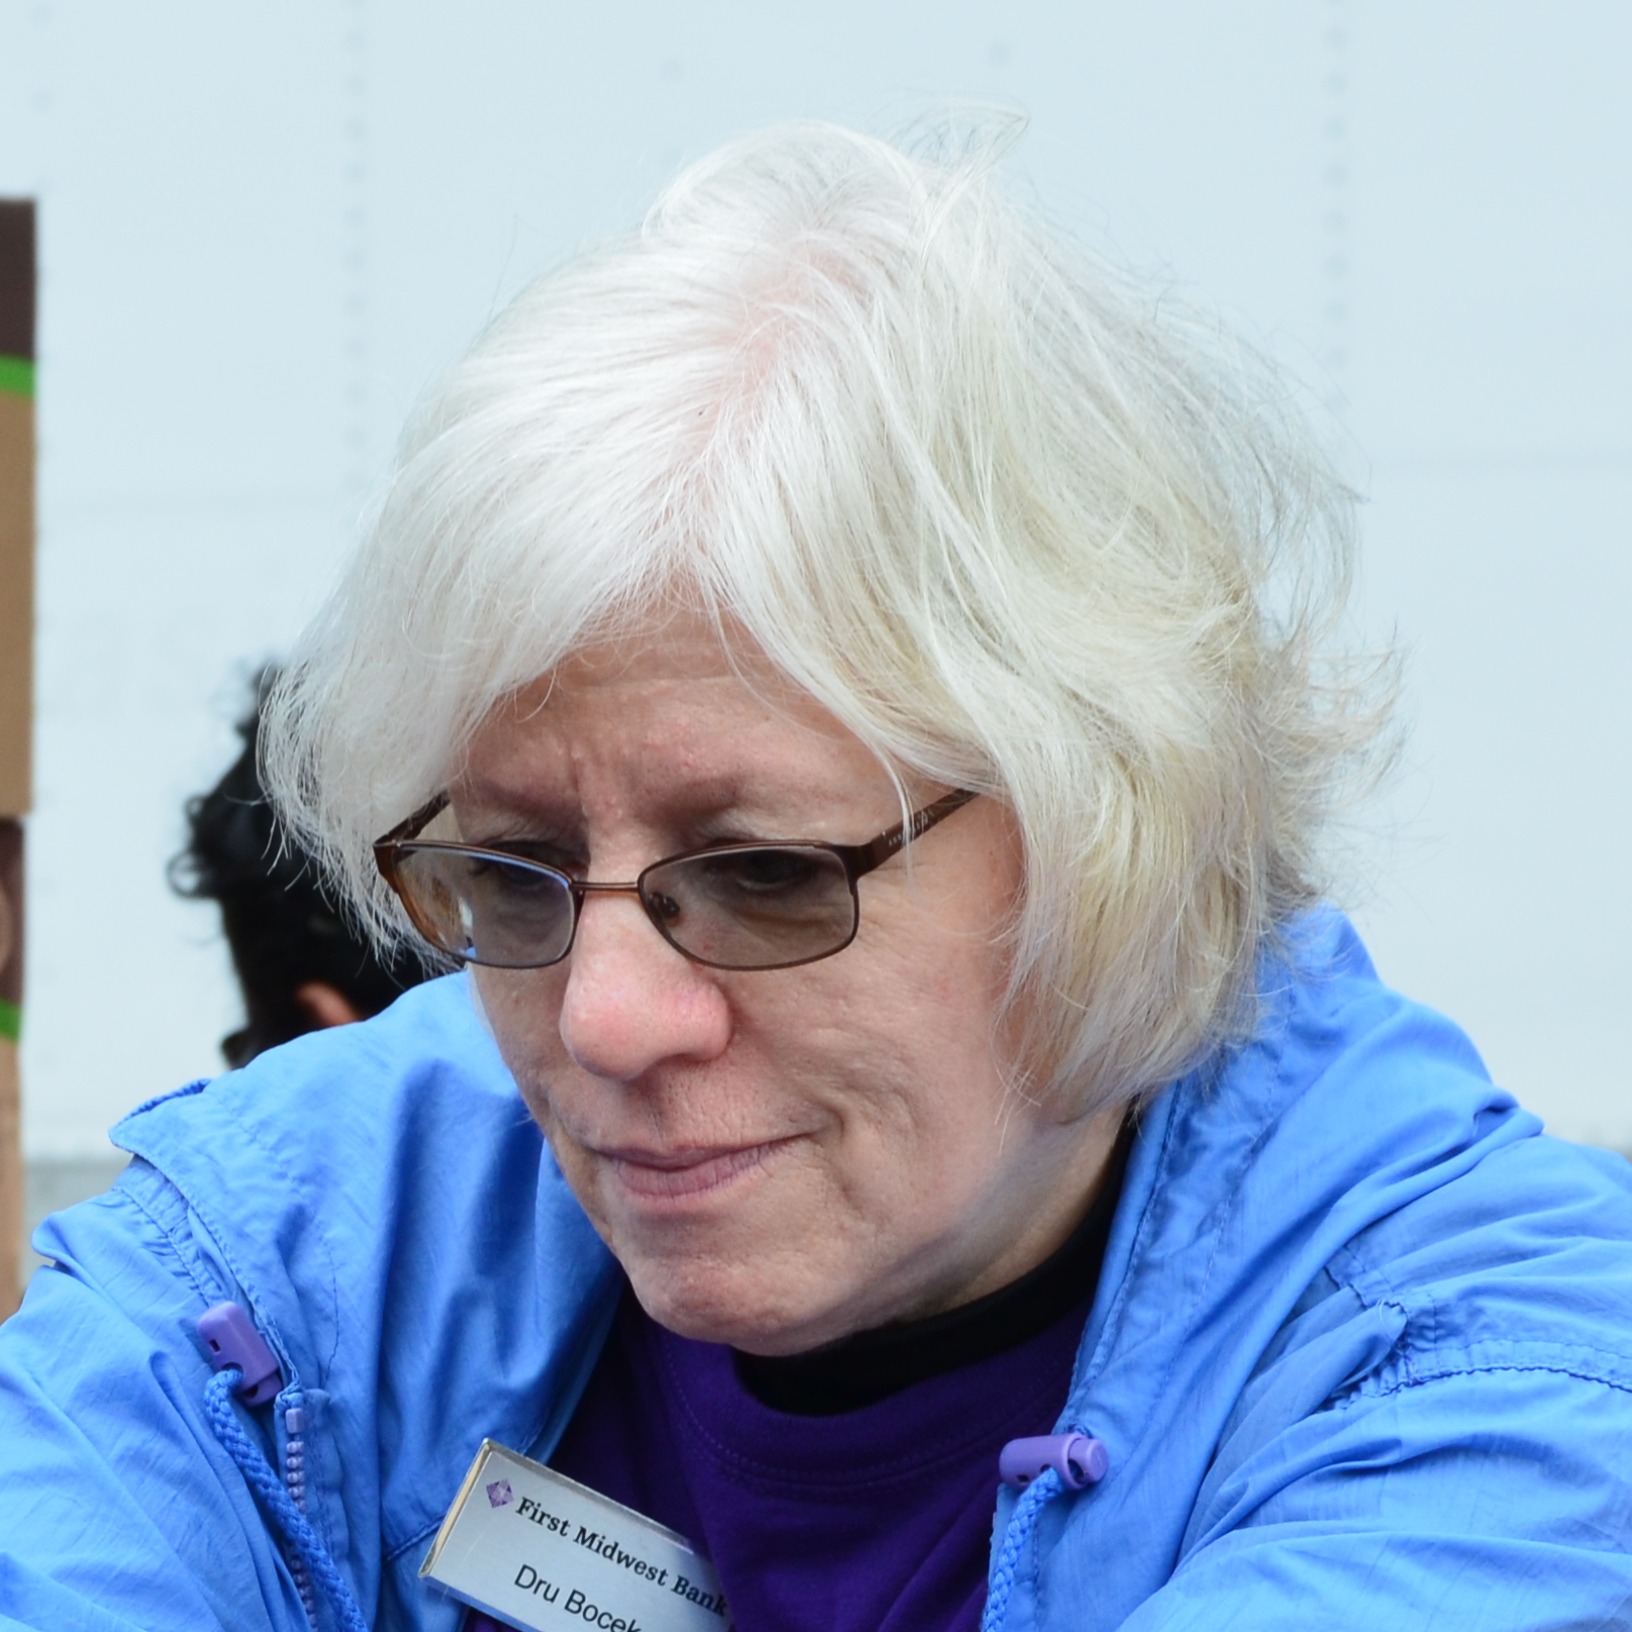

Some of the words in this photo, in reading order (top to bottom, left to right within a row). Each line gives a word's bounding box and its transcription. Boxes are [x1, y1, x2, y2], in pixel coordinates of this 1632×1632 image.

[514, 1496, 572, 1538] First
[573, 1525, 669, 1587] Midwest
[671, 1574, 729, 1619] Bank
[514, 1564, 561, 1604] Dru
